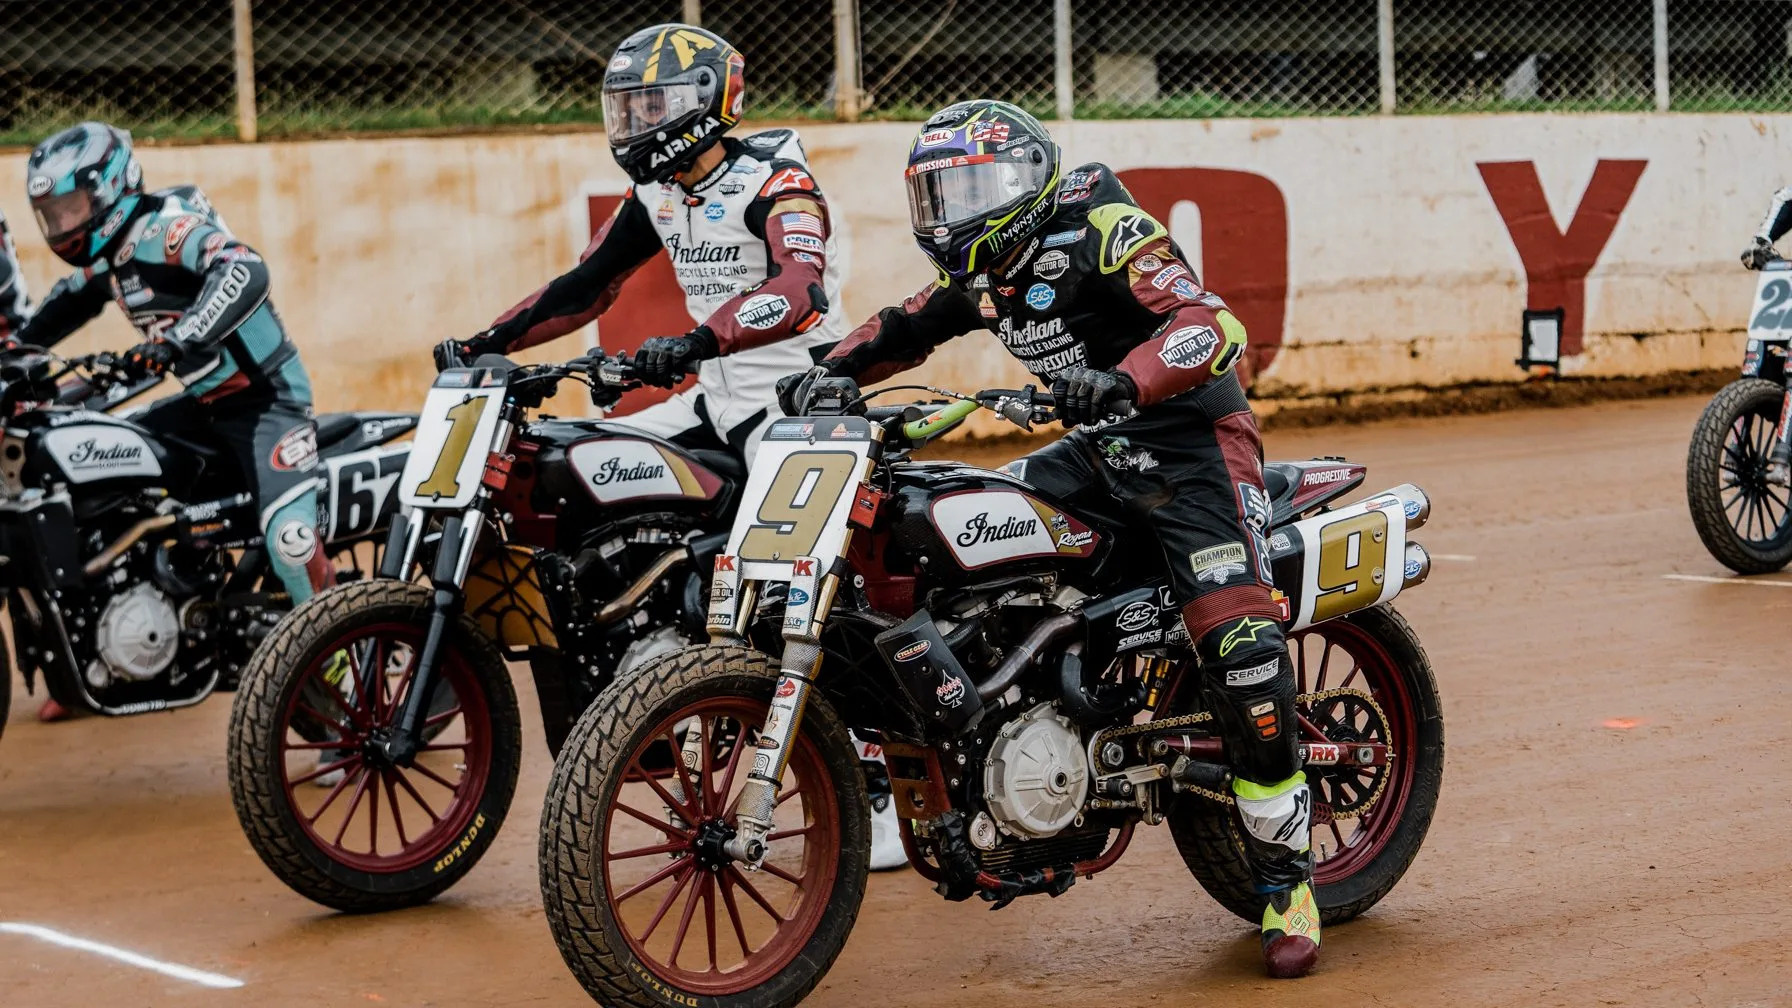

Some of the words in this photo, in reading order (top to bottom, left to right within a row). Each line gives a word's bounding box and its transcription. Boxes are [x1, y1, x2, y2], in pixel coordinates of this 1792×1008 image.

[924, 132, 949, 143] BELL
[666, 233, 741, 263] Indian
[1006, 237, 1039, 280] alpinestars
[711, 264, 748, 277] RACING
[1035, 260, 1057, 273] MOTOR
[1057, 258, 1068, 268] OIL
[1030, 289, 1051, 302] S&S
[1171, 277, 1199, 300] VP
[740, 304, 772, 325] MOTOR
[771, 299, 788, 315] OIL
[998, 316, 1064, 346] Indian
[1043, 333, 1074, 352] RACING
[1163, 338, 1199, 363] MOTOR
[1196, 331, 1216, 346] OIL
[69, 438, 142, 464] Indian
[414, 395, 489, 498] 1
[592, 456, 665, 486] Indian
[1304, 468, 1352, 486] PROGRESSIVE
[738, 450, 858, 563] 9
[956, 512, 1037, 547] Indian
[1195, 546, 1242, 566] CHAMPION
[1311, 511, 1389, 624] 9
[708, 614, 731, 625] orbin
[1121, 607, 1152, 626] S&S
[1118, 628, 1163, 649] SERVICE
[1166, 630, 1191, 642] MOTO
[896, 647, 914, 659] CYCLE
[913, 641, 929, 652] GEAR
[1228, 659, 1278, 681] SERVICE
[1311, 746, 1337, 761] RK
[434, 813, 486, 872] DUNLOP
[631, 962, 699, 1008] DUNLOP
